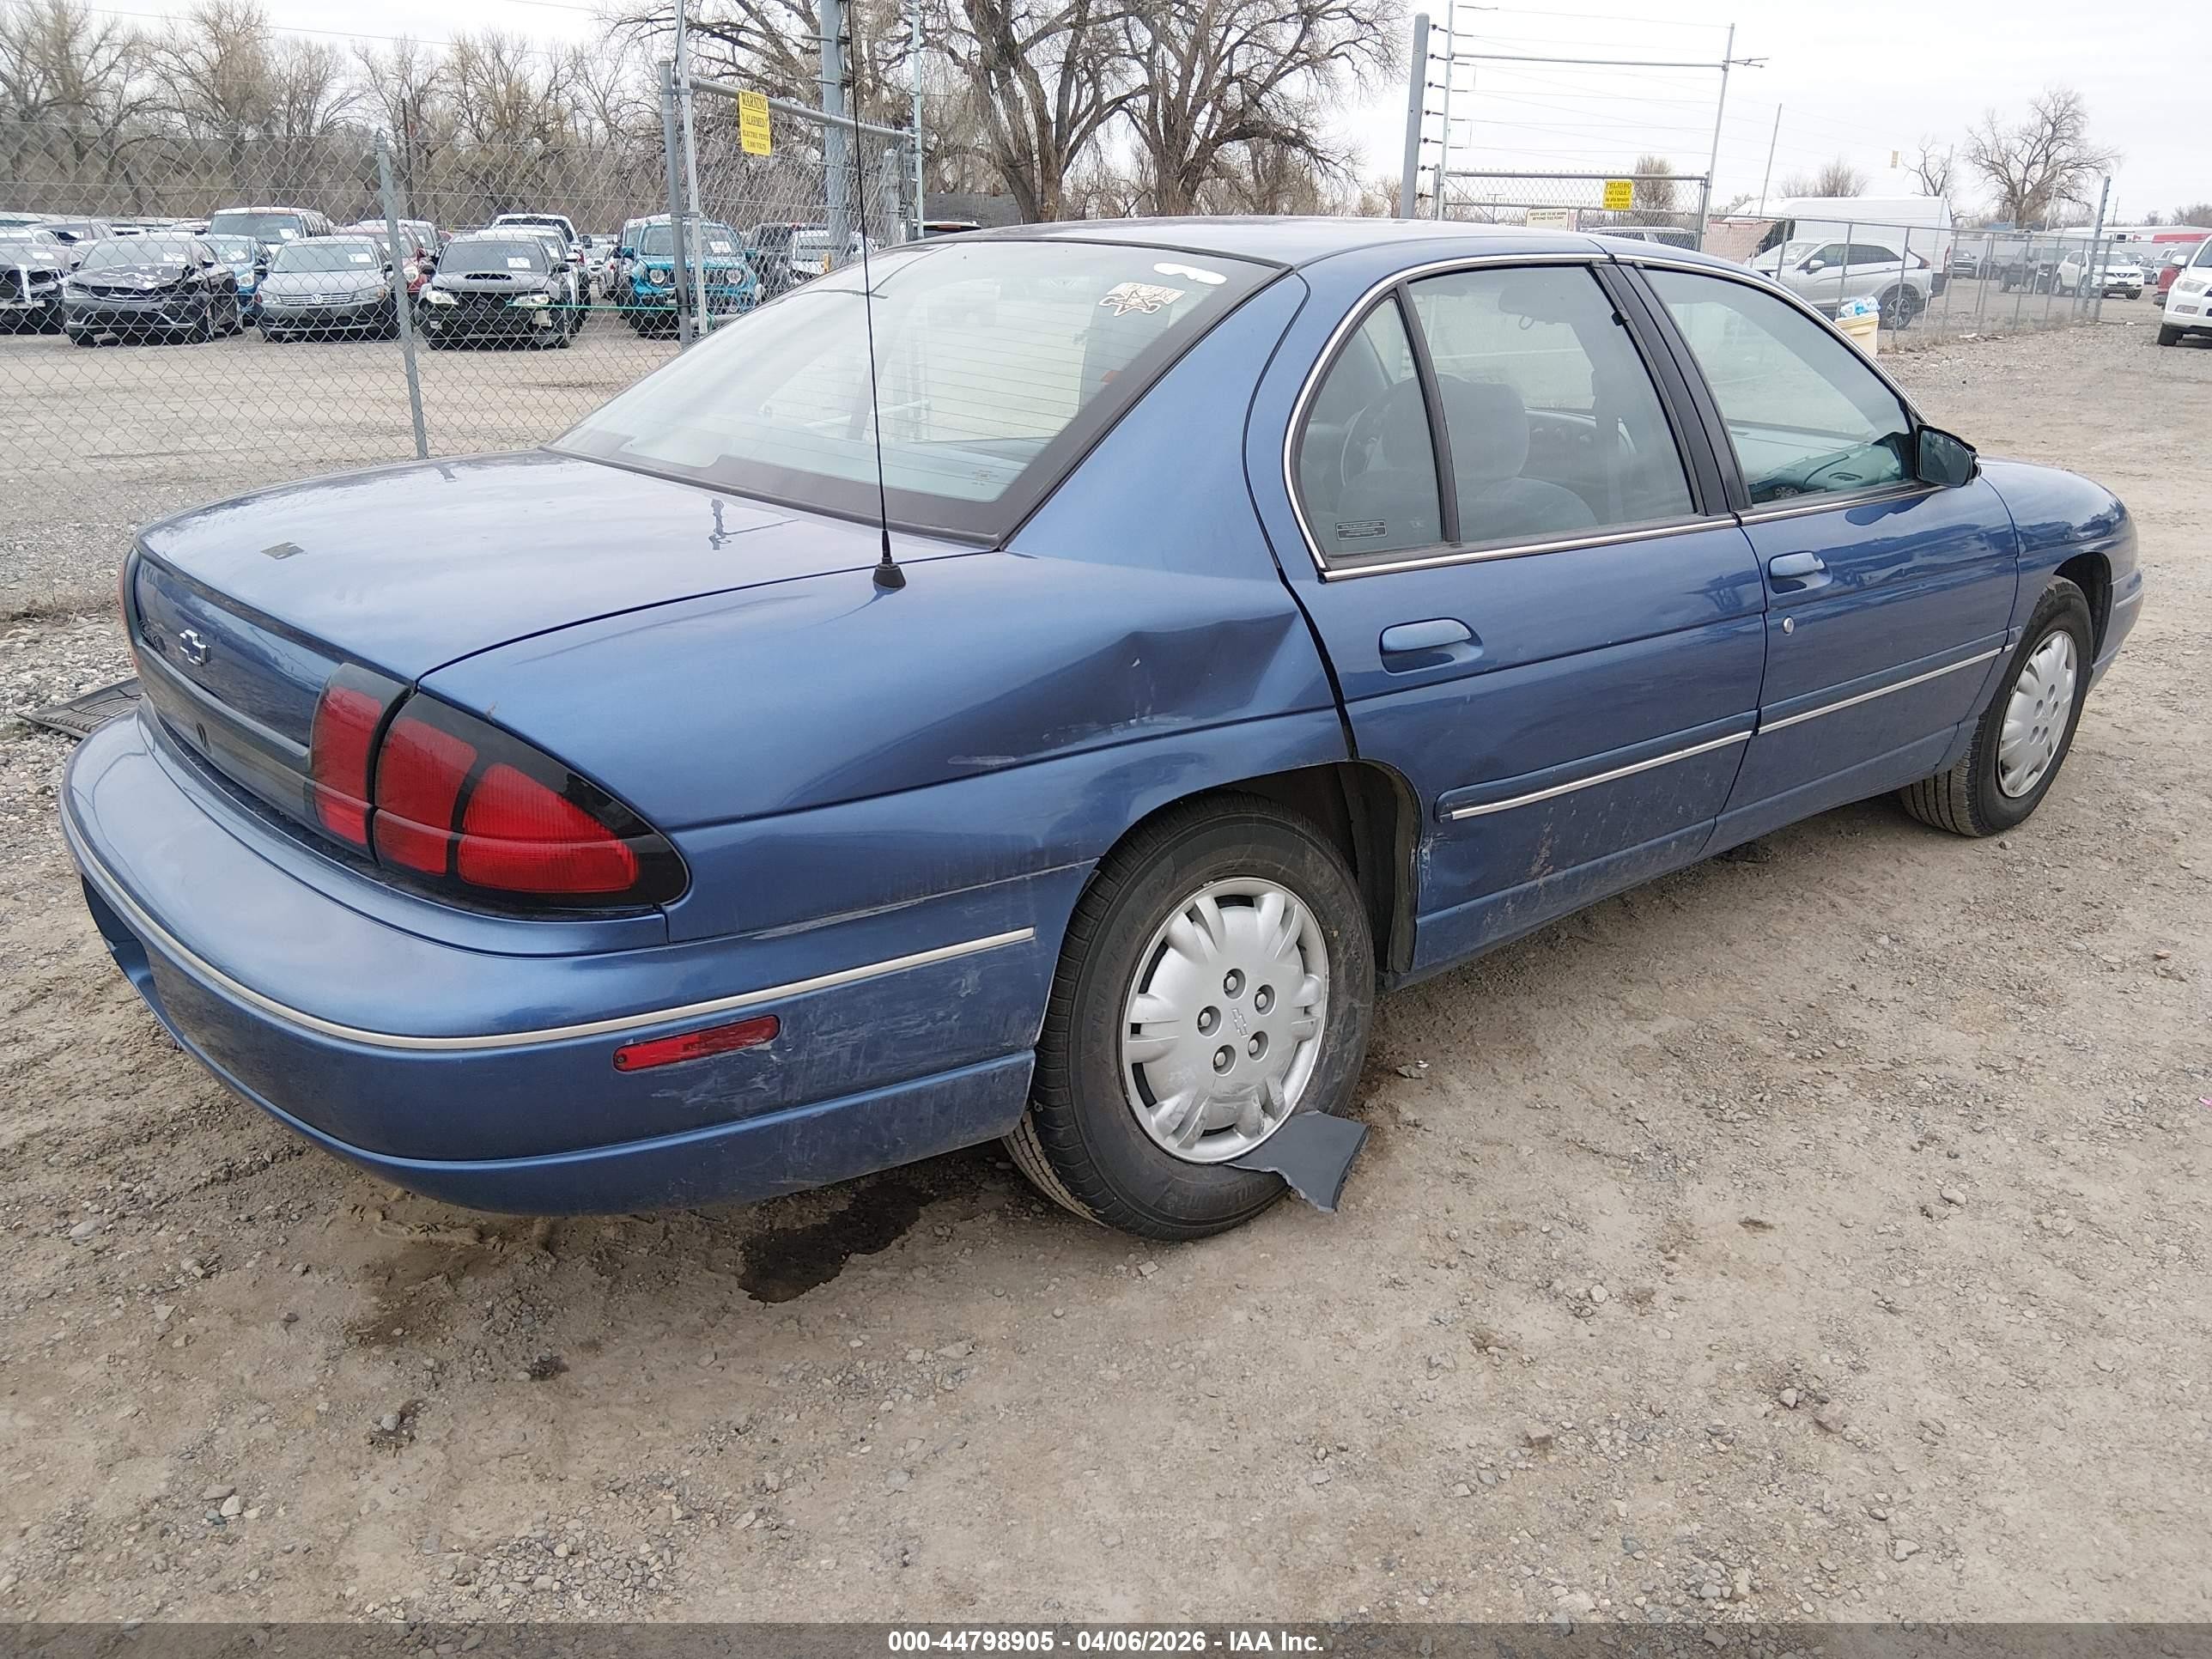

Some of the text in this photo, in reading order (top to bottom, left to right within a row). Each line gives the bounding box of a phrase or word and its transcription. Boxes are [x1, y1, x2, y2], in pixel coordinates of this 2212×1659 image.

[741, 93, 767, 111] WARNING
[742, 130, 769, 142] ELECTRIC FENCE
[757, 142, 767, 150] VOLTS
